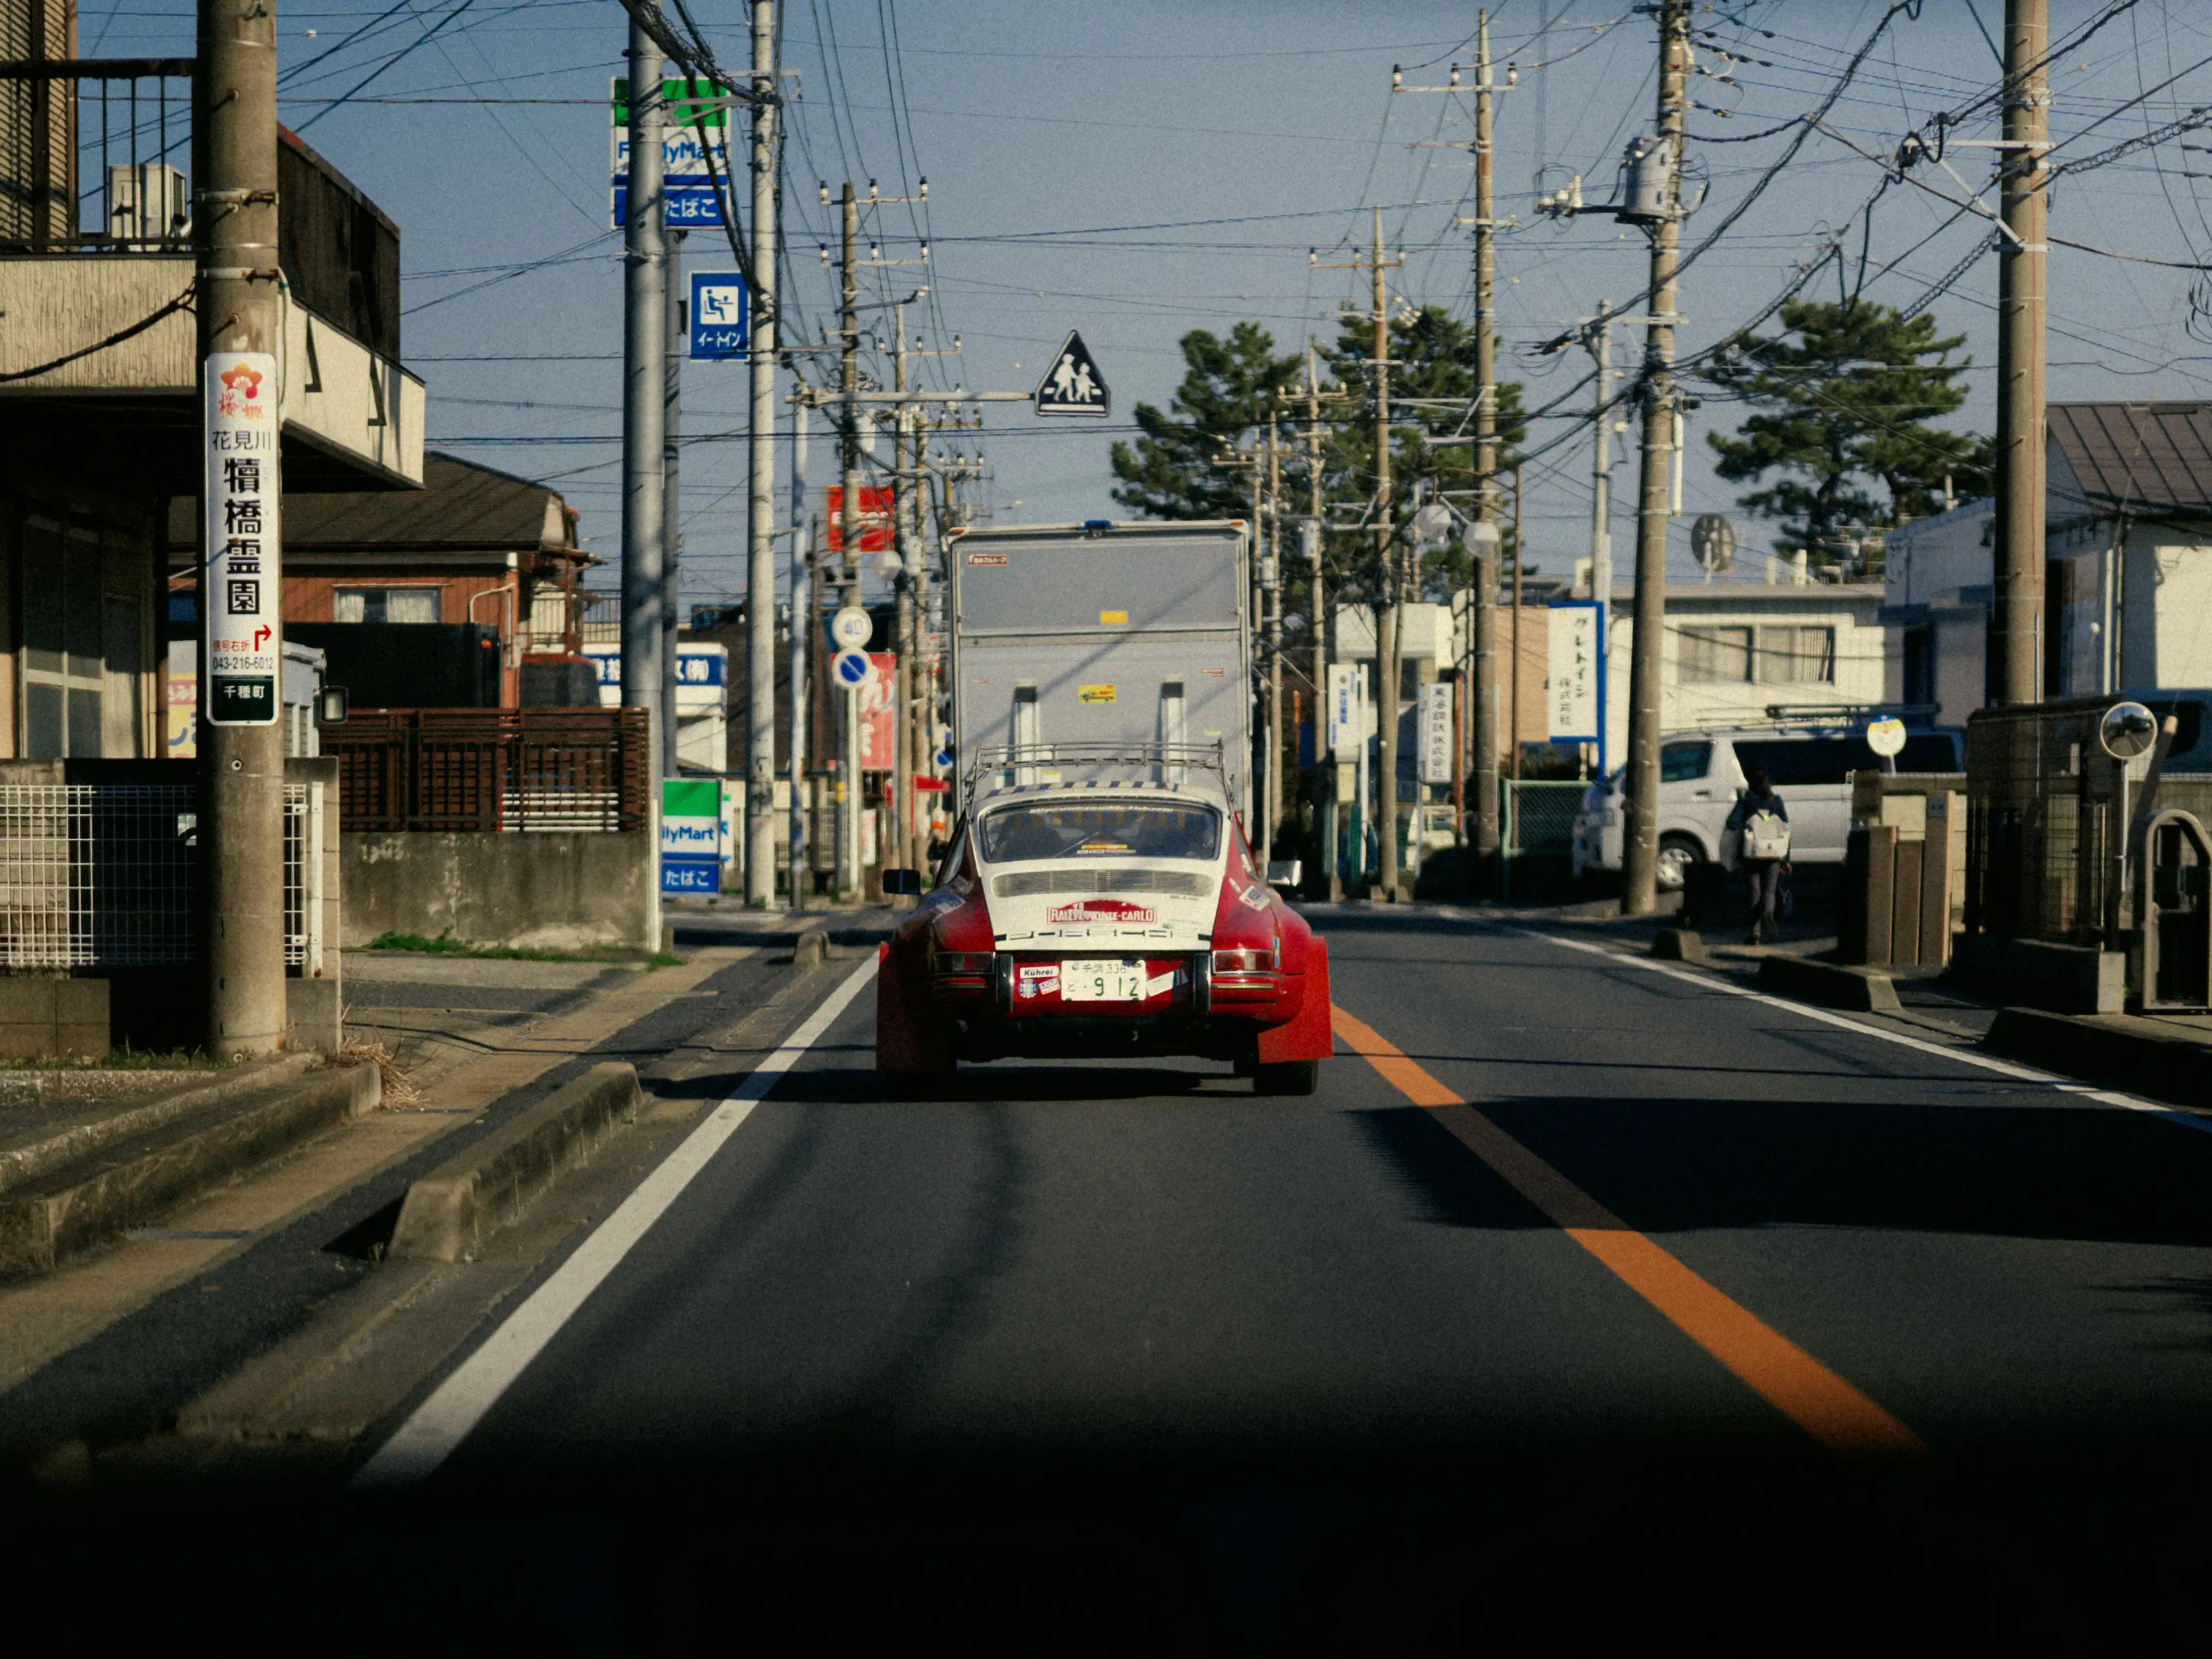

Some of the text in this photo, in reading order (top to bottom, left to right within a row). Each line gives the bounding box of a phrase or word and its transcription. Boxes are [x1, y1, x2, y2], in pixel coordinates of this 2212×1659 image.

[618, 142, 724, 164] FlyMat
[212, 430, 270, 450] 花見川
[223, 458, 261, 614] 犢橋霊園
[213, 640, 250, 652] 信号右折
[213, 656, 273, 669] 043-216-6012
[223, 685, 265, 699] 千種町
[666, 870, 709, 886] たばこ
